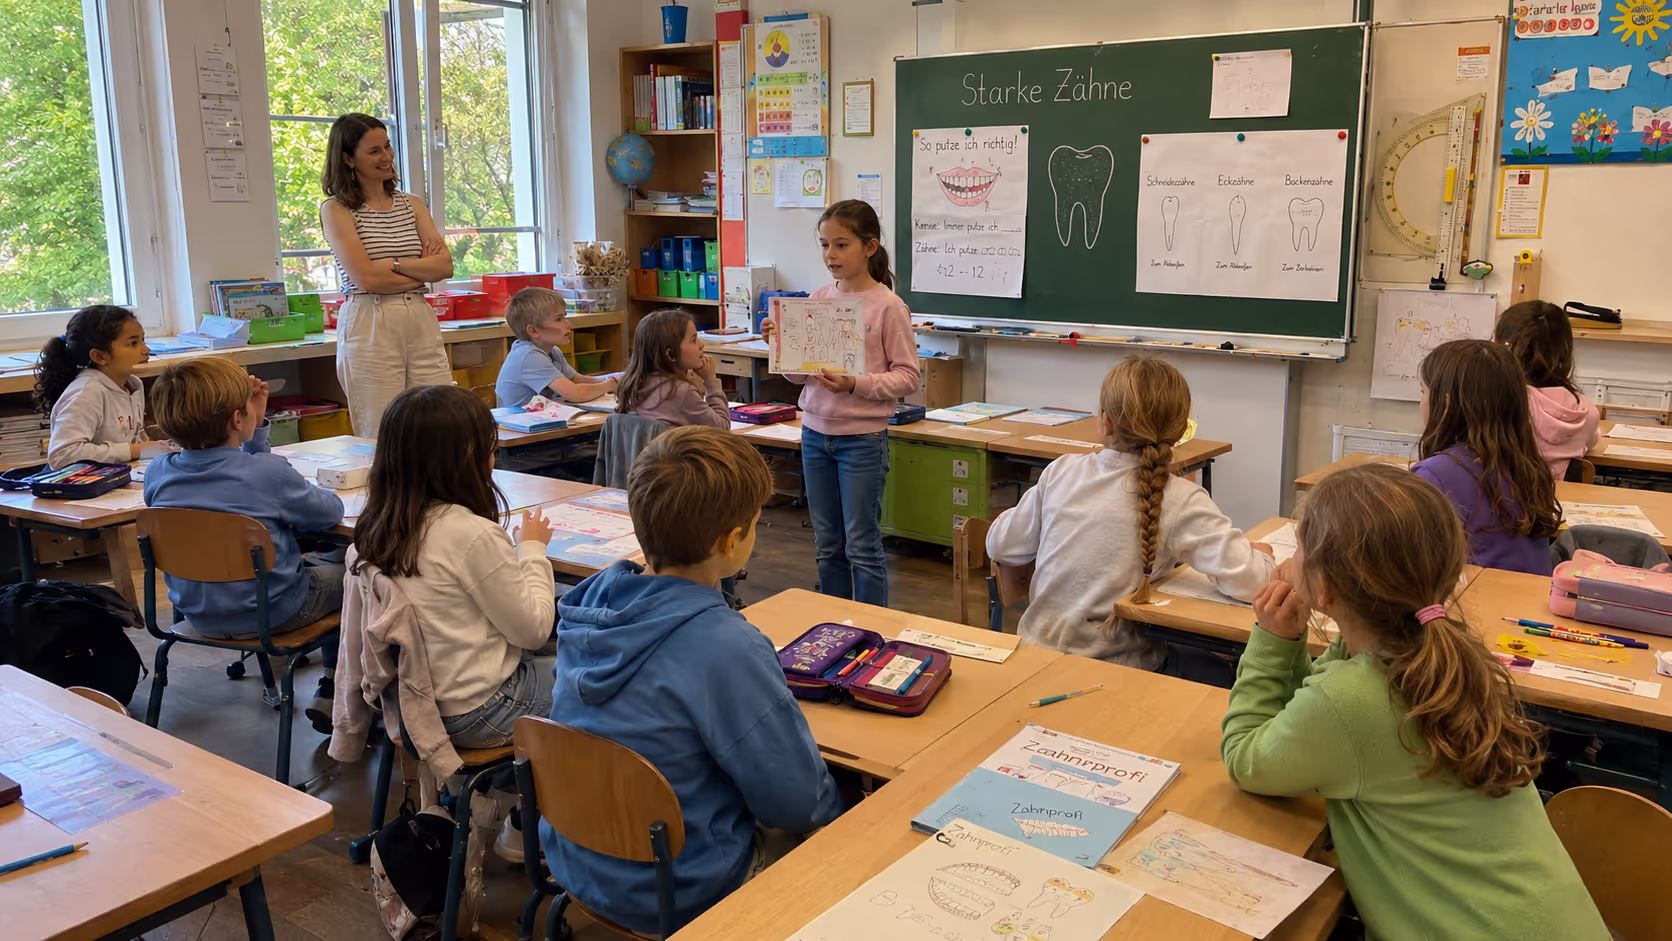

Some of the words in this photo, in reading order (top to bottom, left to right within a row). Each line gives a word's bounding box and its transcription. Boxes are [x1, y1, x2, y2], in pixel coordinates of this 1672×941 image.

[962, 70, 1042, 106] Starke
[1054, 67, 1132, 102] Zähne
[920, 137, 932, 151] So
[936, 139, 960, 155] putze
[965, 137, 978, 150] ich
[983, 135, 1018, 155] richtig!
